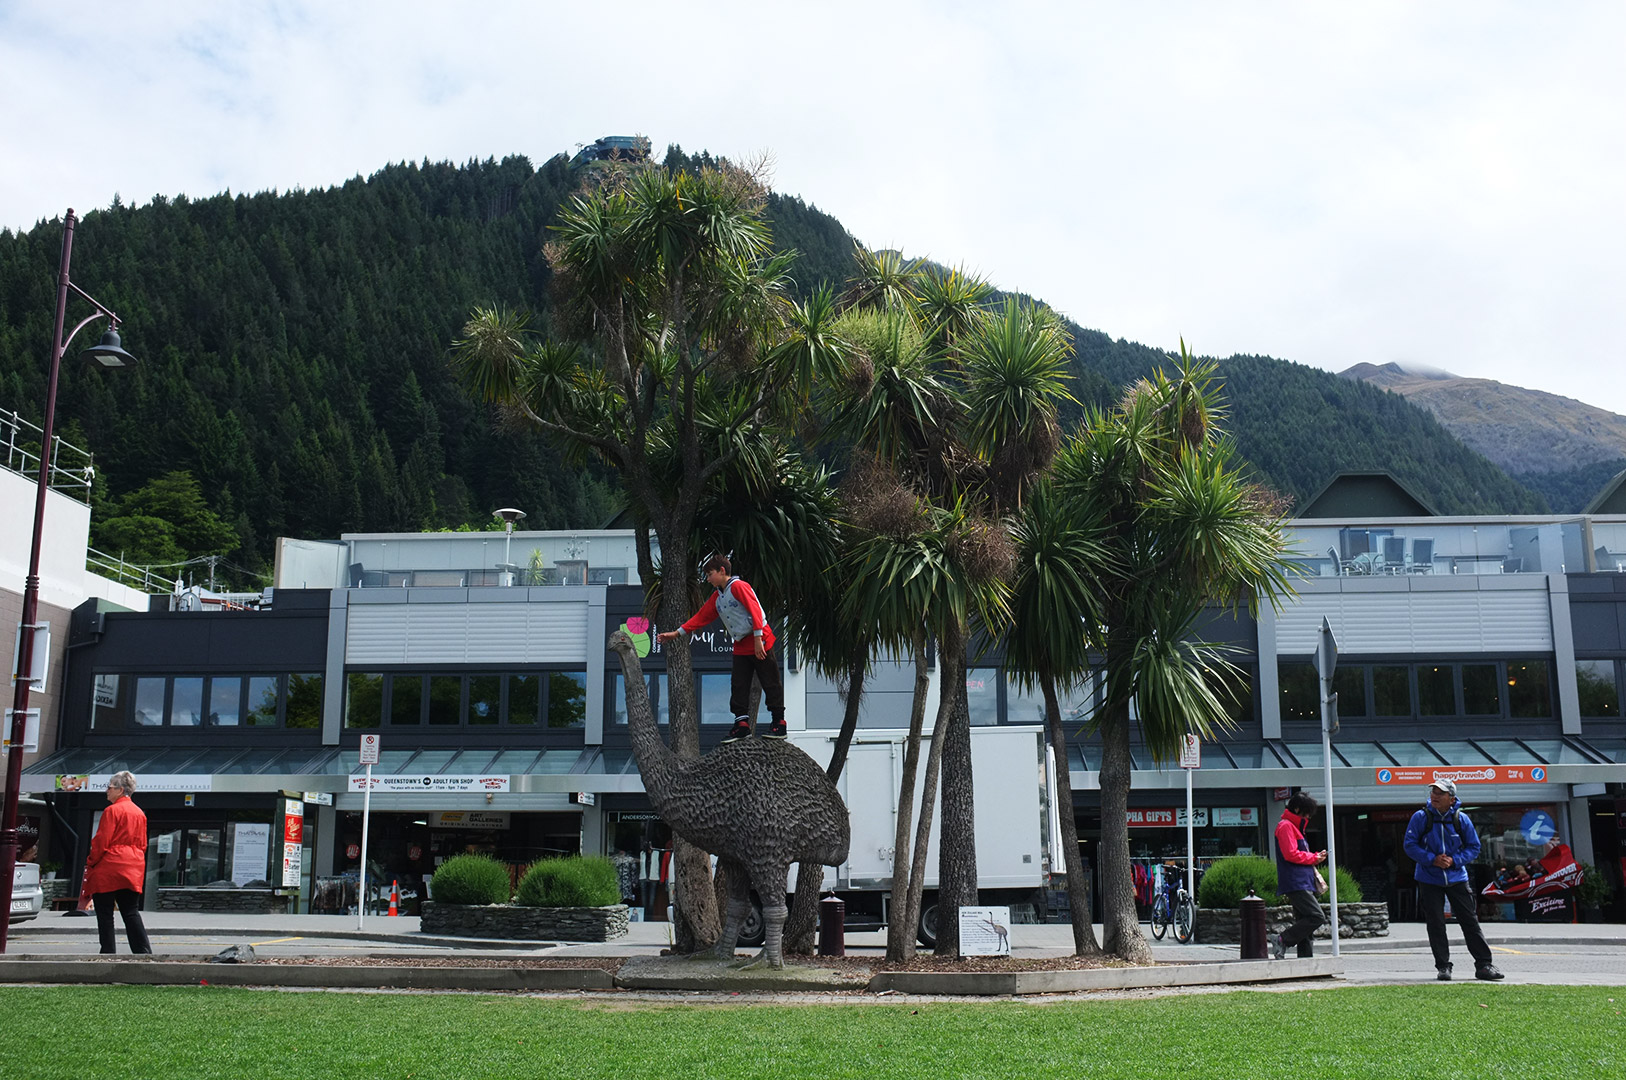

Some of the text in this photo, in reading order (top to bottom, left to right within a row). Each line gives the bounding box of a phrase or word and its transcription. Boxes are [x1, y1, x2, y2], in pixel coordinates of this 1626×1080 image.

[965, 680, 984, 689] PEN
[1127, 811, 1172, 823] PHA GIFTS
[1544, 862, 1577, 882] SHOTOVER
